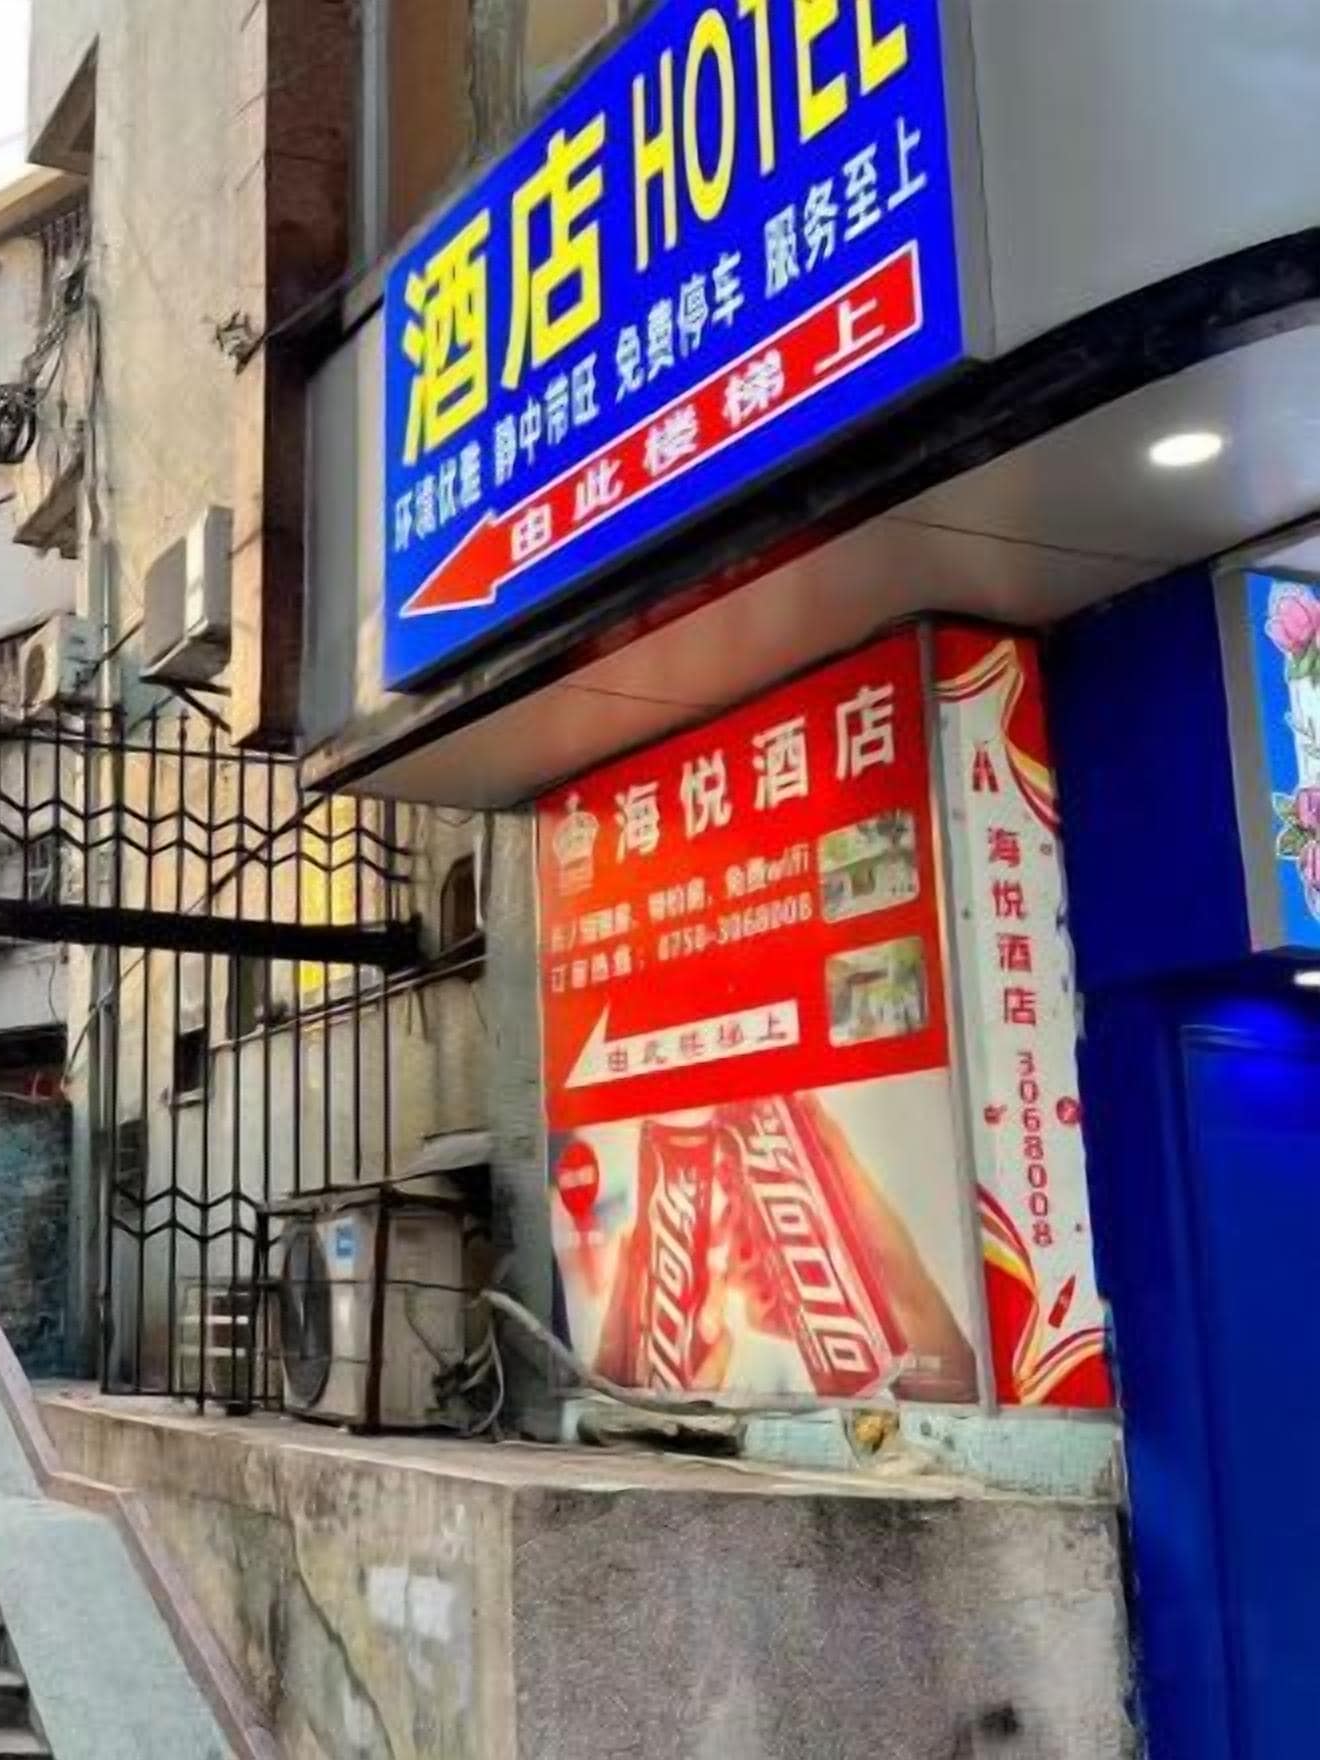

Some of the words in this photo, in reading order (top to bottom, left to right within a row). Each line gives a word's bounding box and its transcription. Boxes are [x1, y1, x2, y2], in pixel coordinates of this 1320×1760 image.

[402, 112, 605, 467] 酒店
[632, 0, 909, 273] HOTEL
[616, 251, 745, 404] 免费停车
[763, 116, 928, 300] 服务至上
[614, 682, 896, 865] 海悦酒店
[986, 826, 1040, 1027] 海悦酒店
[1016, 1050, 1053, 1249] 3068008
